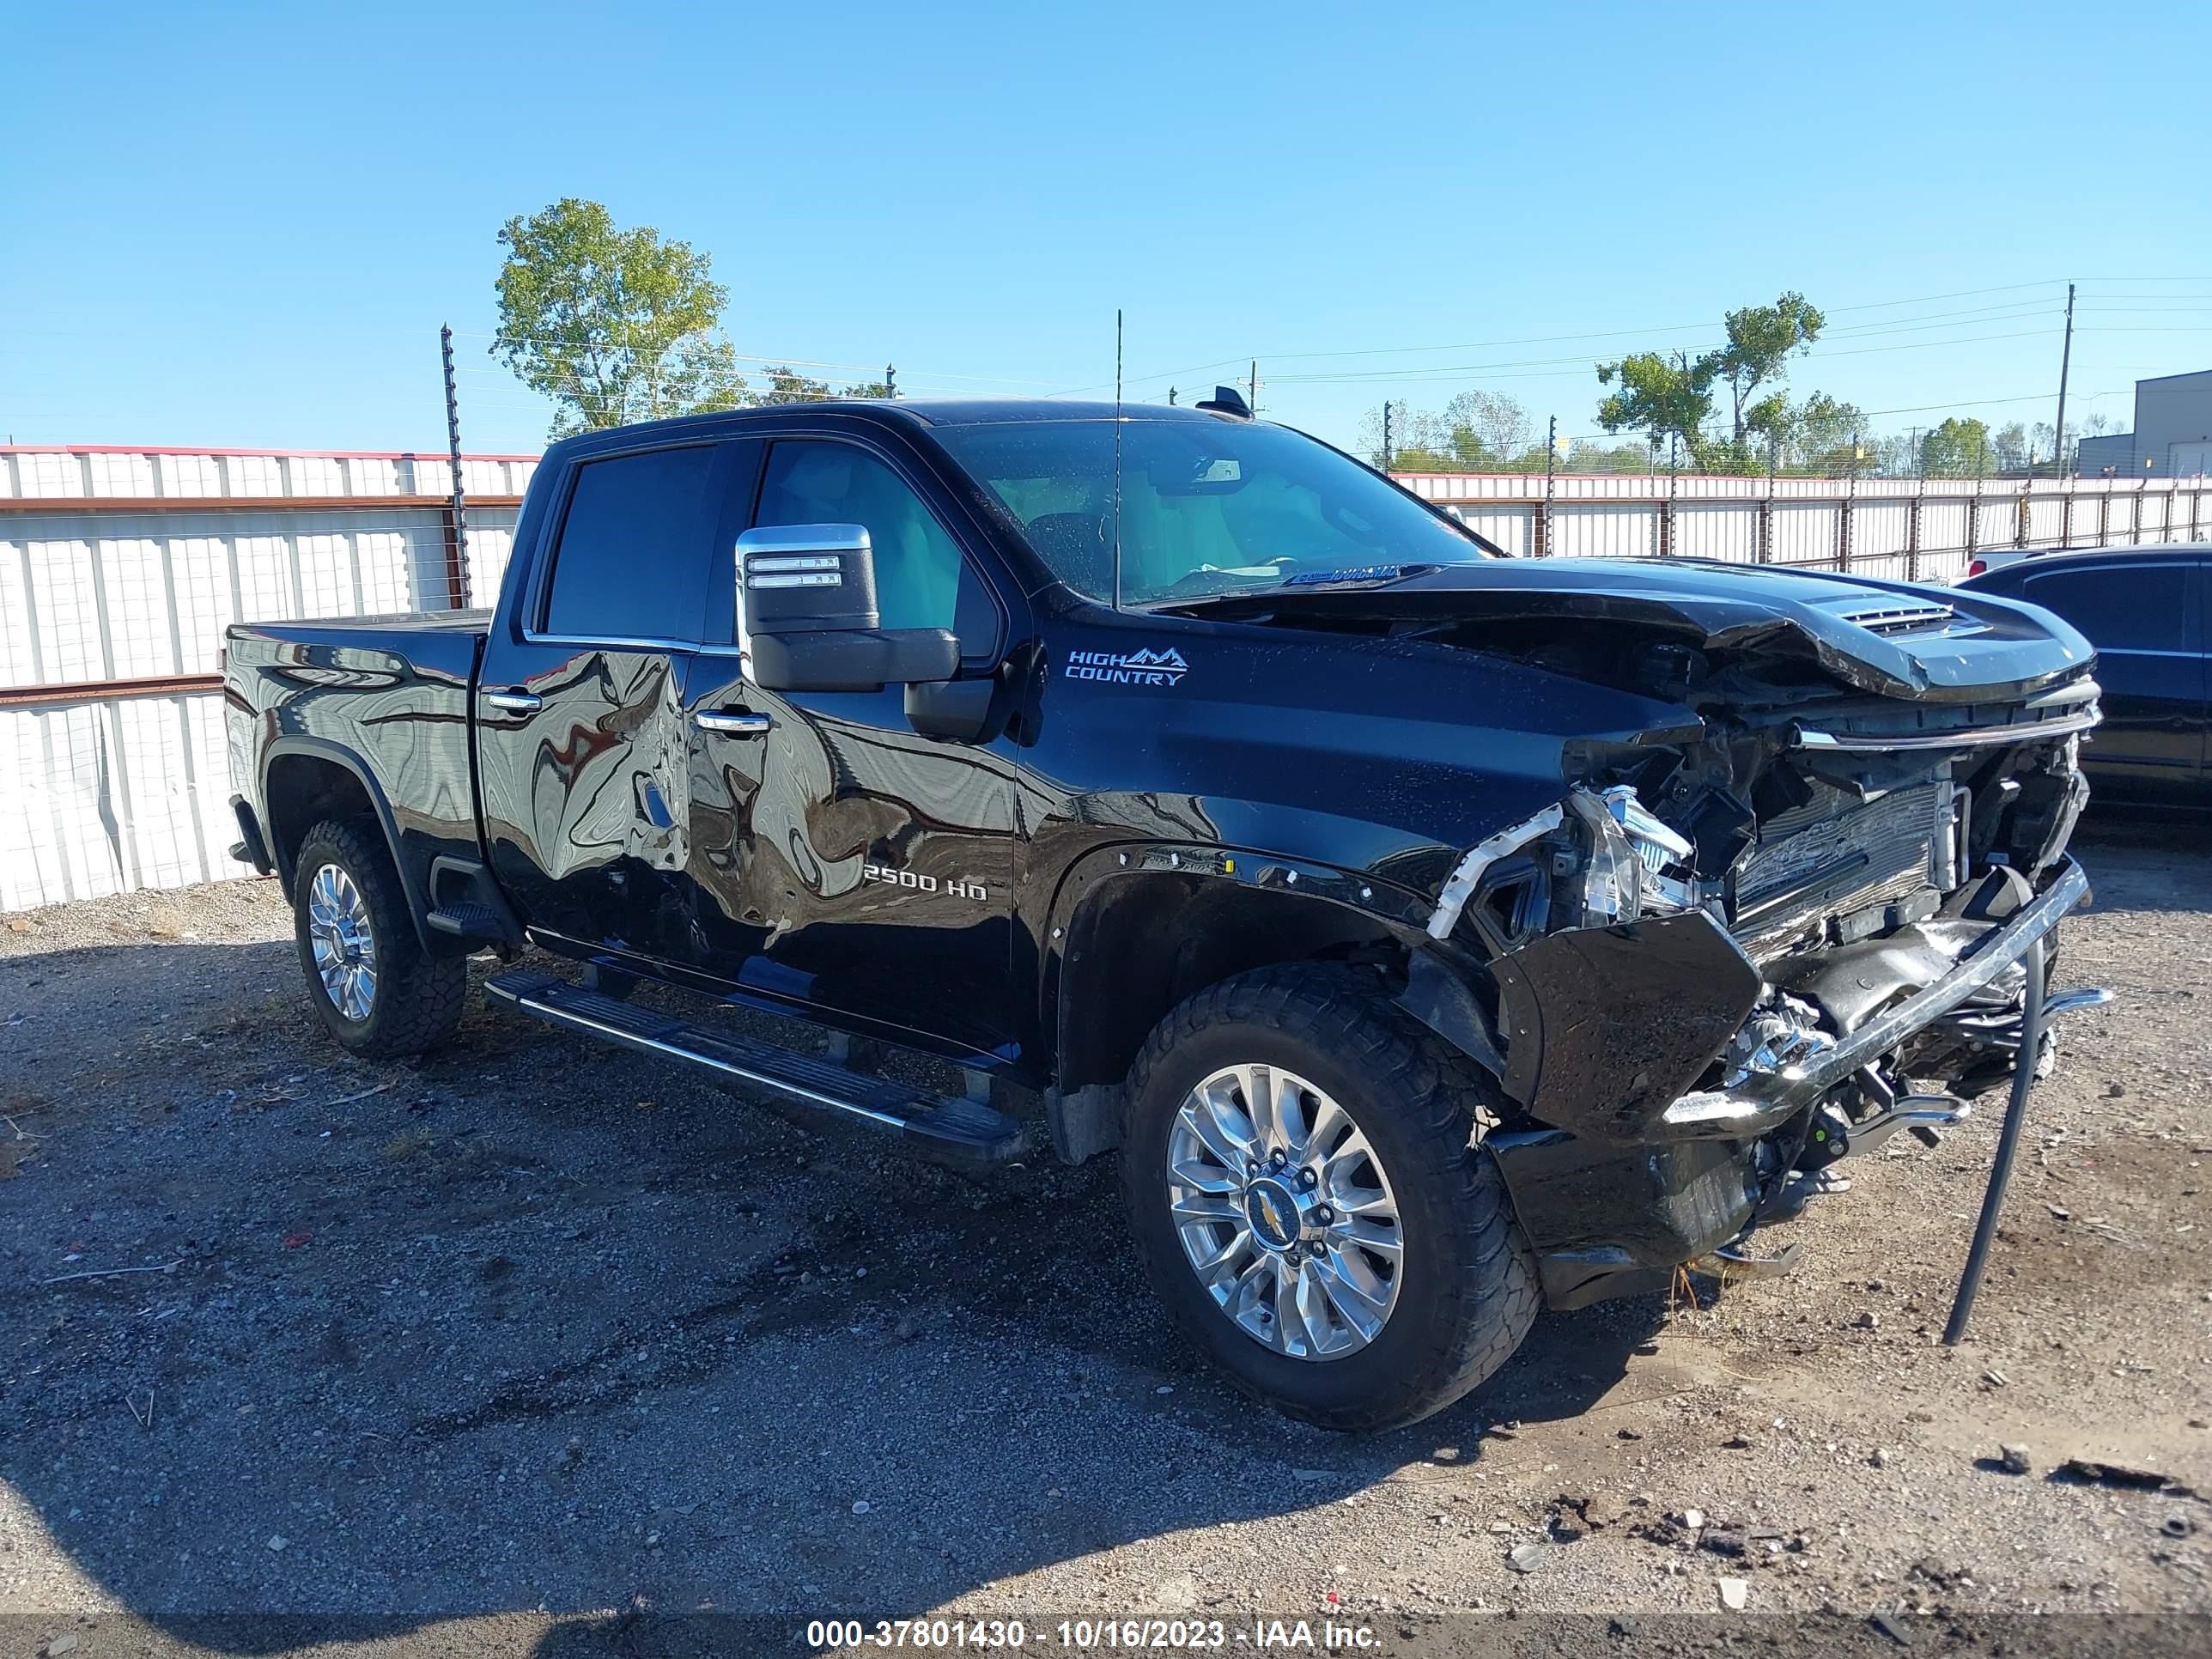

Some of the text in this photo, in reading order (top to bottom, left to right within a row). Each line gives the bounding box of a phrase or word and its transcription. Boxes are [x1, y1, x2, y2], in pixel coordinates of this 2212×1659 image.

[1068, 651, 1127, 667] HIGH
[1065, 665, 1186, 687] COUNTRY
[863, 863, 988, 902] 2500 HD
